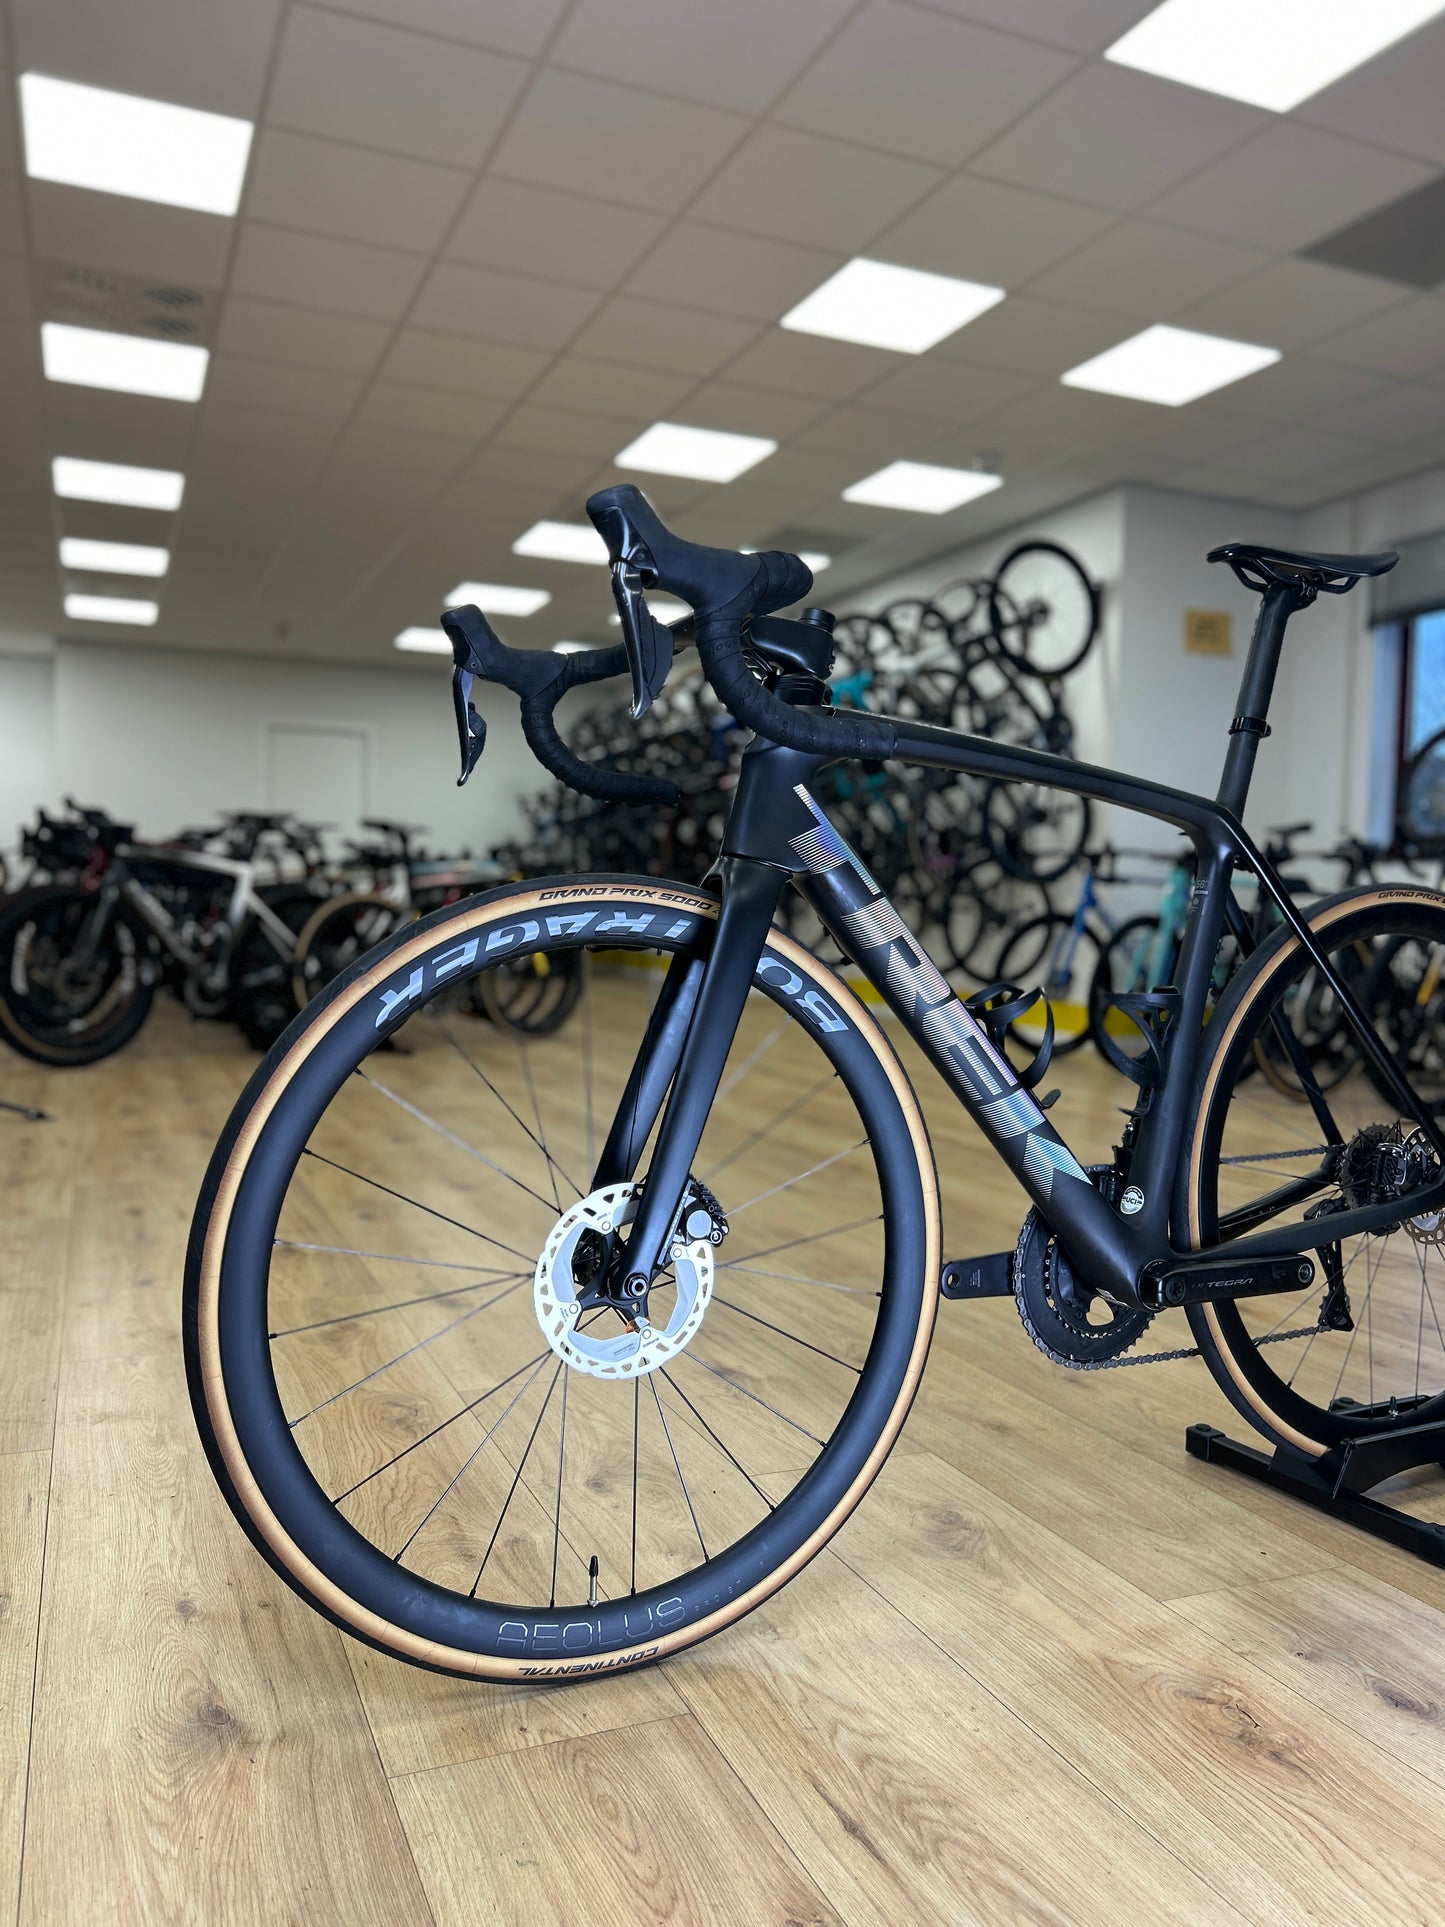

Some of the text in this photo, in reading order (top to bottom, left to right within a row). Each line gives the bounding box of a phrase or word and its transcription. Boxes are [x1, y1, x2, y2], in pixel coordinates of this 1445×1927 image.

[539, 887, 713, 910] GRAND PRIX 5000
[1378, 890, 1441, 902] GRAND PRIX
[375, 910, 849, 1033] BOTRAGER
[787, 784, 1093, 1202] TREK
[496, 1596, 686, 1650] AEOLUS
[519, 1646, 660, 1676] CONTINENTAL
